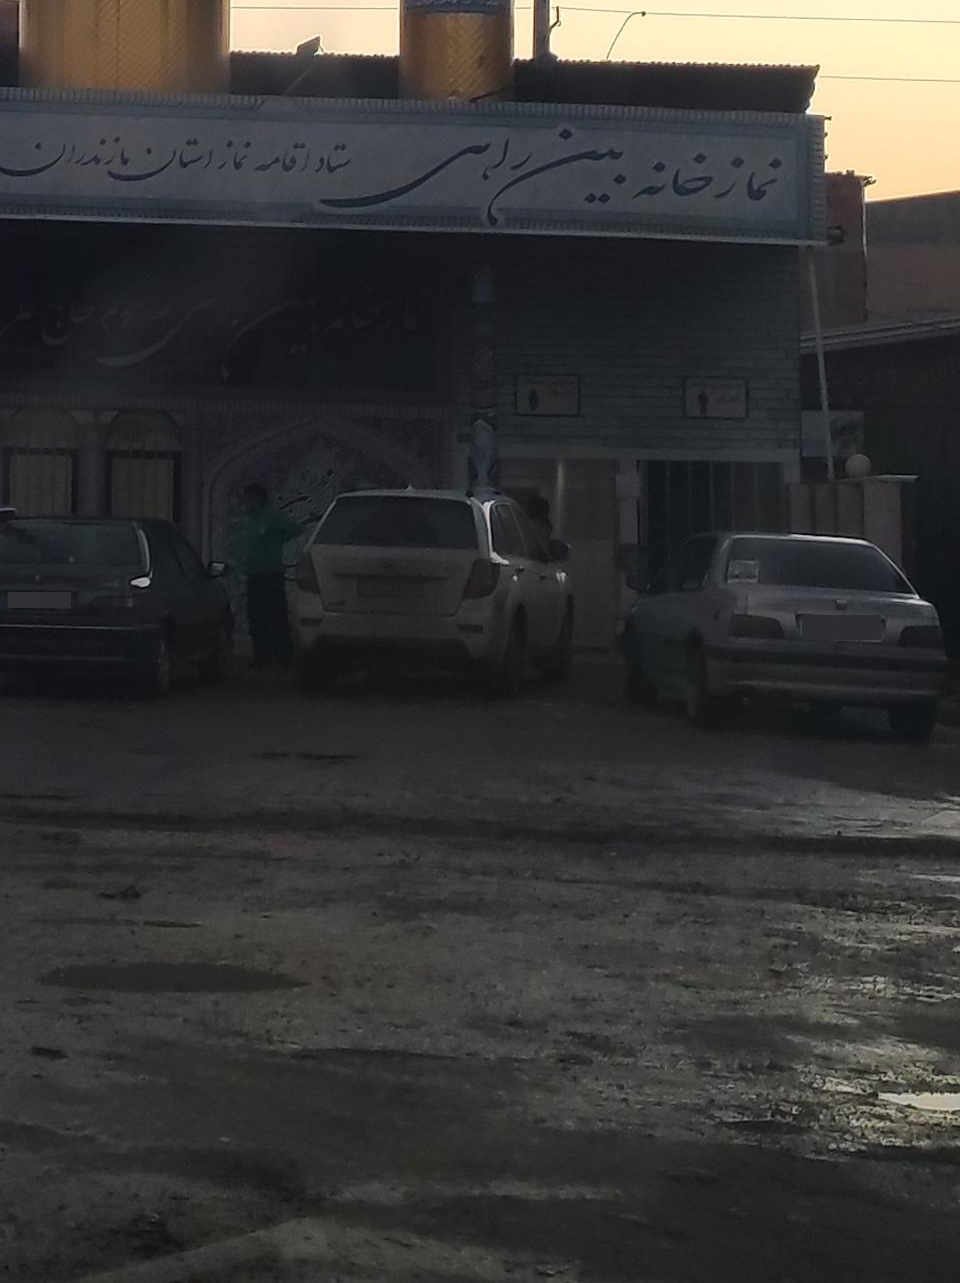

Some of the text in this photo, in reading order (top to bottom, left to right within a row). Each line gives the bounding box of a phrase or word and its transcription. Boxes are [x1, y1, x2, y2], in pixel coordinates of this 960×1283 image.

[106, 138, 213, 182] استان
[218, 140, 252, 171] نماز
[254, 142, 309, 173] اقامه
[316, 143, 352, 173] ستاد
[320, 138, 532, 207] راهی
[488, 128, 627, 225] بین
